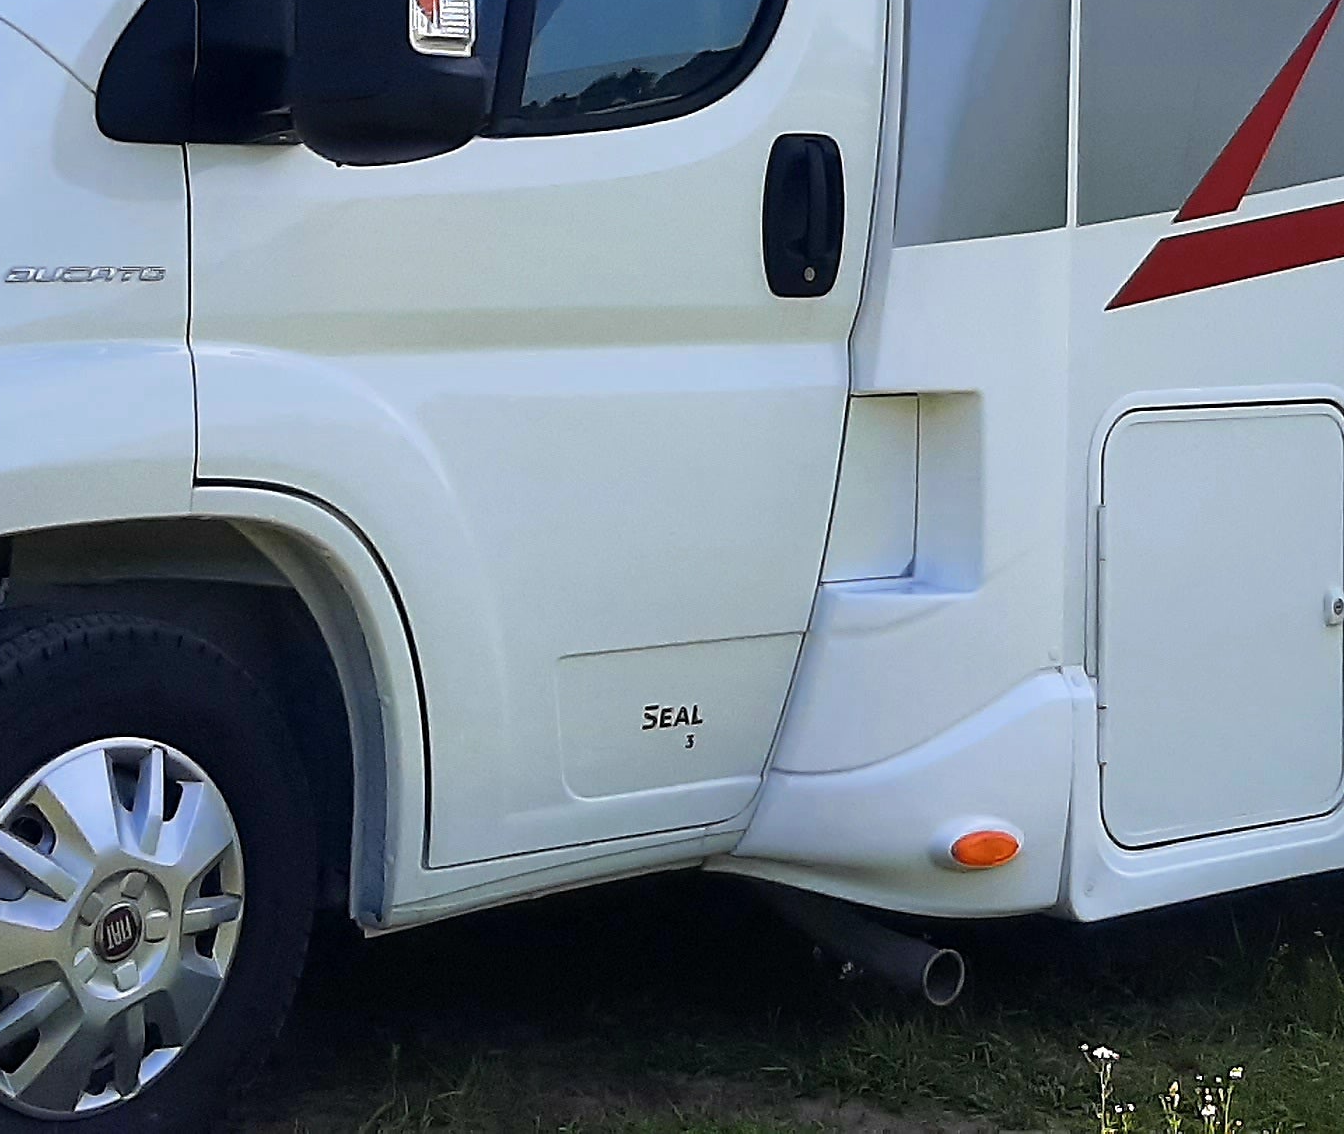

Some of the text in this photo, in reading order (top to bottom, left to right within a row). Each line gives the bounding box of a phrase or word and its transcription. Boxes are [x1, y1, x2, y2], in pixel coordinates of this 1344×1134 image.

[4, 265, 166, 284] DUCATO
[641, 704, 703, 731] SEAL
[106, 914, 133, 950] FIAT
